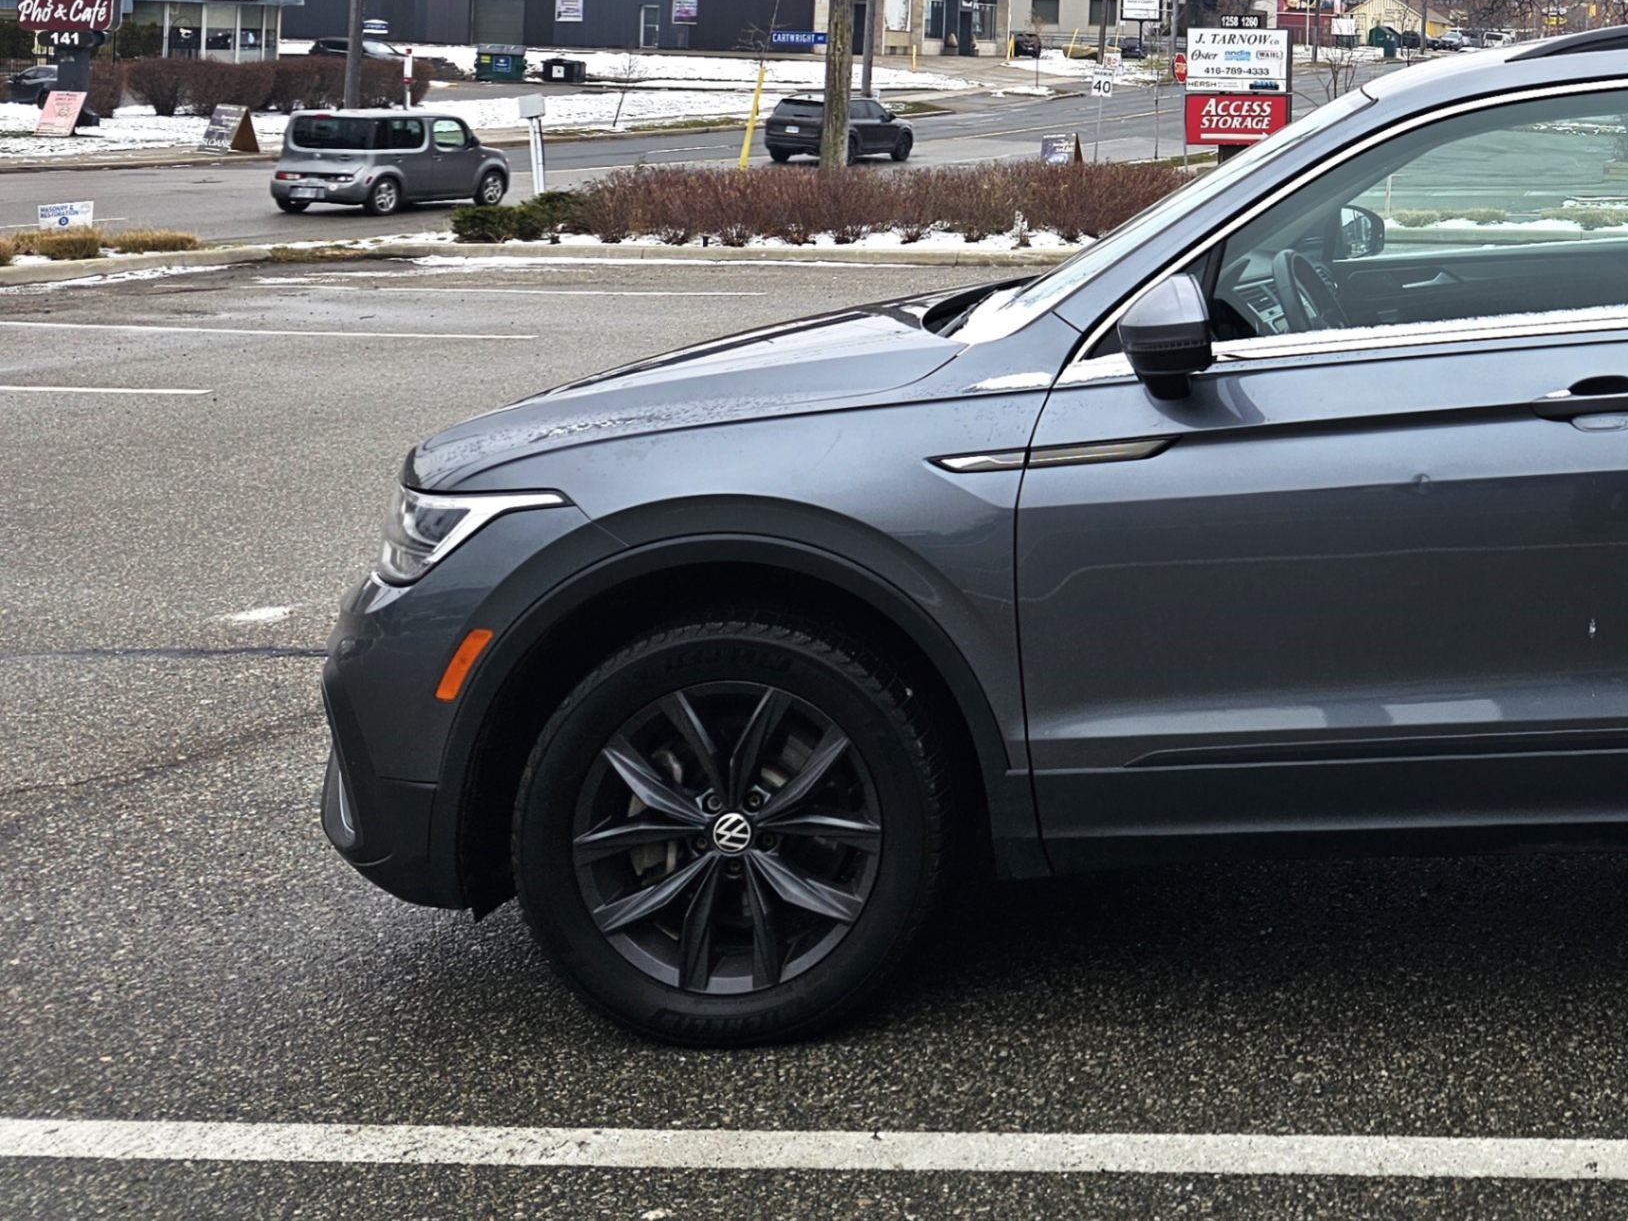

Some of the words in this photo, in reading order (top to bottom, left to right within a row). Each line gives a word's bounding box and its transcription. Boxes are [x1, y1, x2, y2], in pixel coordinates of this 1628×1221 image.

[53, 3, 67, 21] &
[1221, 16, 1239, 27] 1258
[1241, 16, 1259, 27] 1260
[50, 32, 80, 45] 141
[772, 33, 815, 43] CARTWRIGHT
[1210, 33, 1272, 46] TARNOW
[1191, 49, 1218, 60] Oster
[1204, 67, 1270, 76] 416-789-4333
[1093, 80, 1111, 93] 40
[1201, 98, 1272, 116] ACCESS
[1200, 116, 1271, 129] STORAGE
